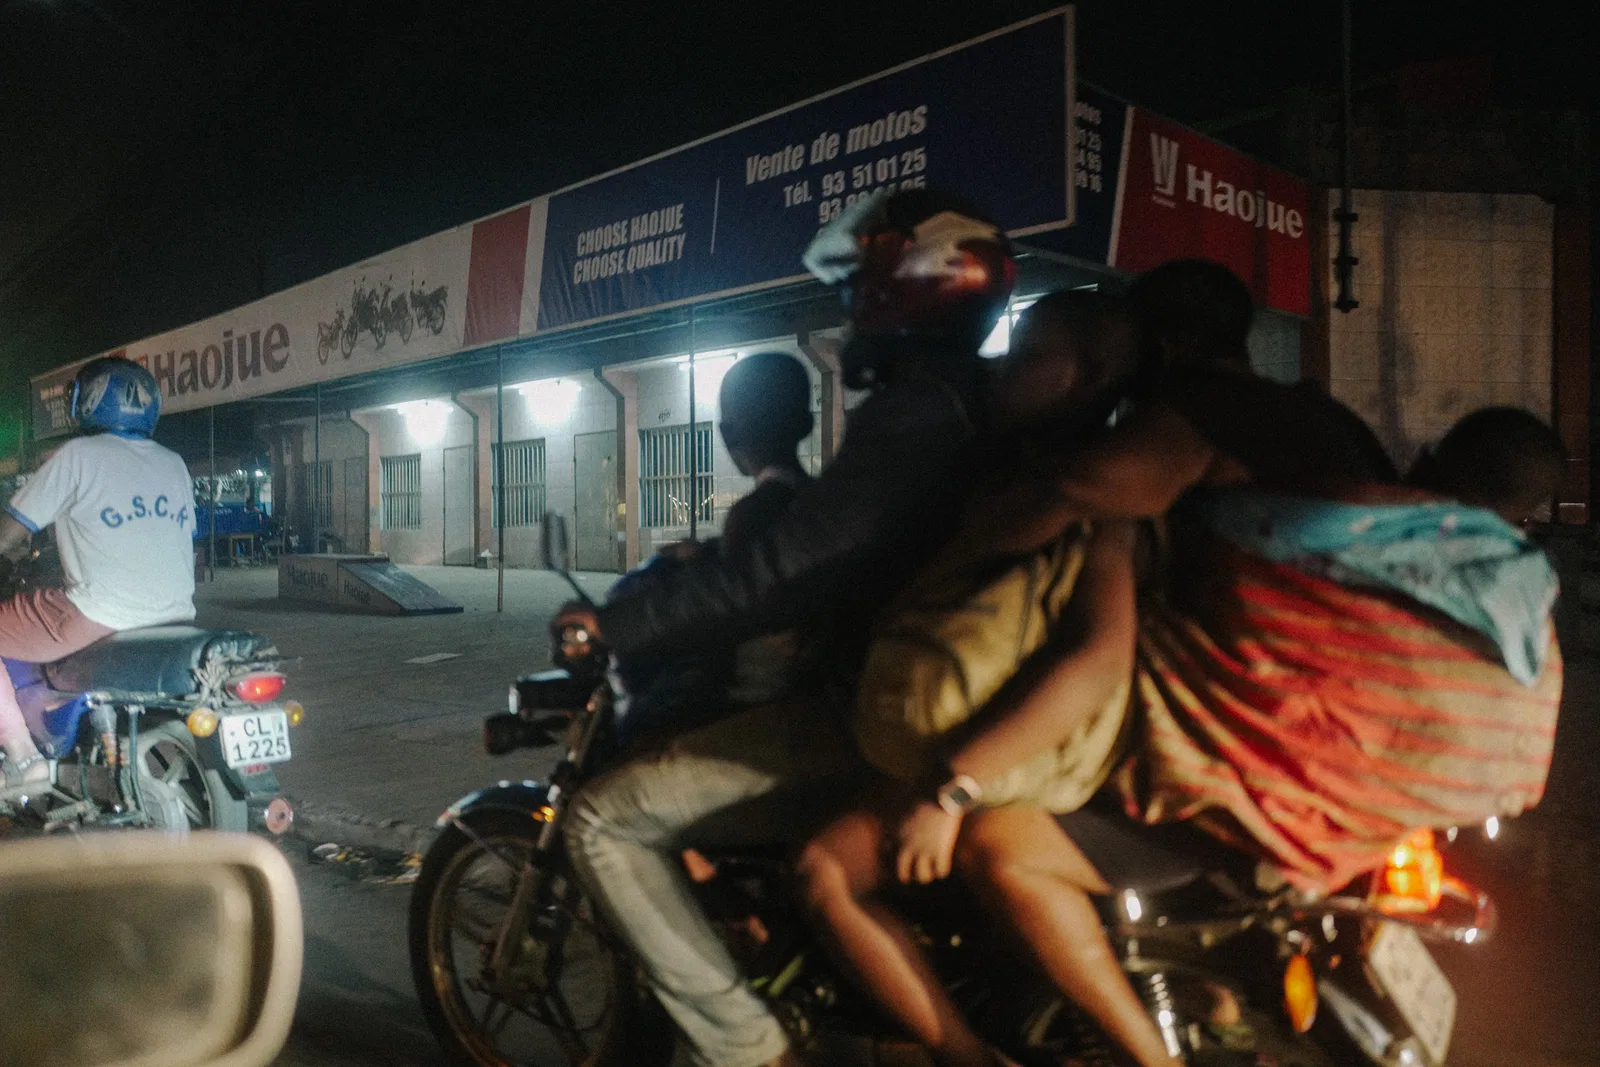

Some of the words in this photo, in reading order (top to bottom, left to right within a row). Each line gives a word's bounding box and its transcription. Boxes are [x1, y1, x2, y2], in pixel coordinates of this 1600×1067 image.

[746, 144, 805, 186] Vente
[809, 131, 840, 165] de
[845, 104, 928, 154] motos
[783, 180, 813, 209] Tél.
[822, 170, 846, 198] 93
[852, 162, 873, 189] 51
[876, 155, 898, 183] 01
[900, 146, 927, 176] 25
[1186, 162, 1304, 239] Haojue
[573, 249, 626, 286] CHOOSE
[626, 233, 687, 274] QUALITY
[577, 219, 629, 257] CHOOSE
[153, 323, 290, 398] Haojue
[233, 737, 287, 762] 1225
[243, 716, 271, 738] CL
